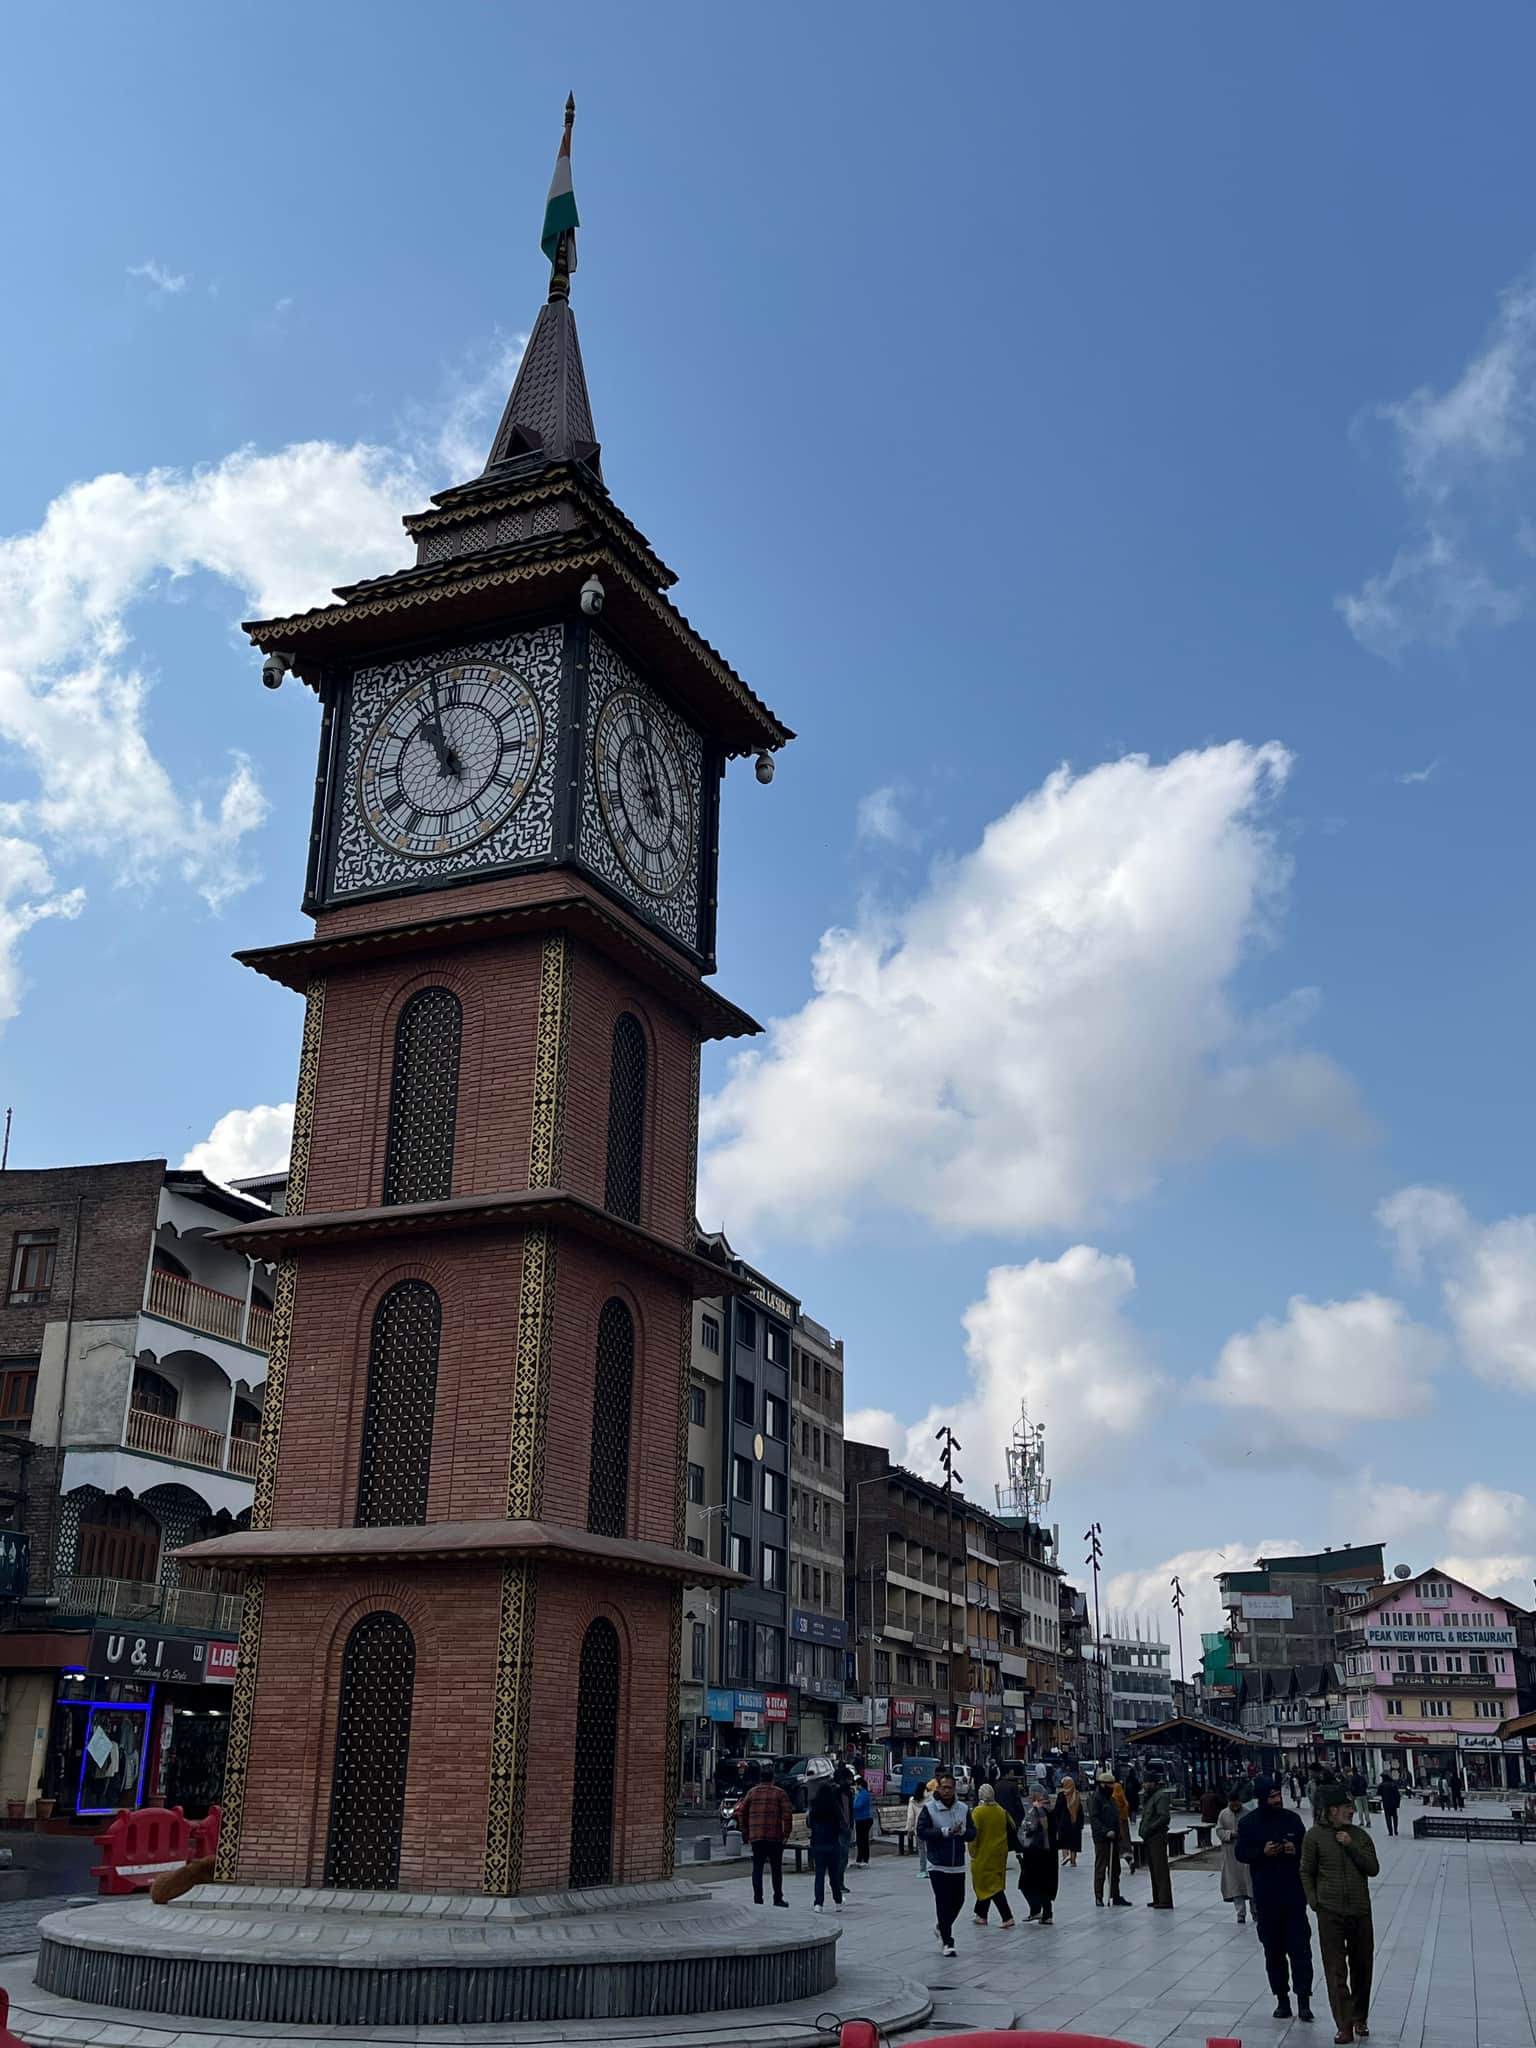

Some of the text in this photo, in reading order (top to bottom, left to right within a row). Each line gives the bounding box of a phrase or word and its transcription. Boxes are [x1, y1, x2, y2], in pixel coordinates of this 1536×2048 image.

[1369, 1630, 1513, 1643] PEAK VIEW HOTEL & RESTAURANT
[107, 1635, 165, 1667] U & I
[700, 1718, 708, 1728] P
